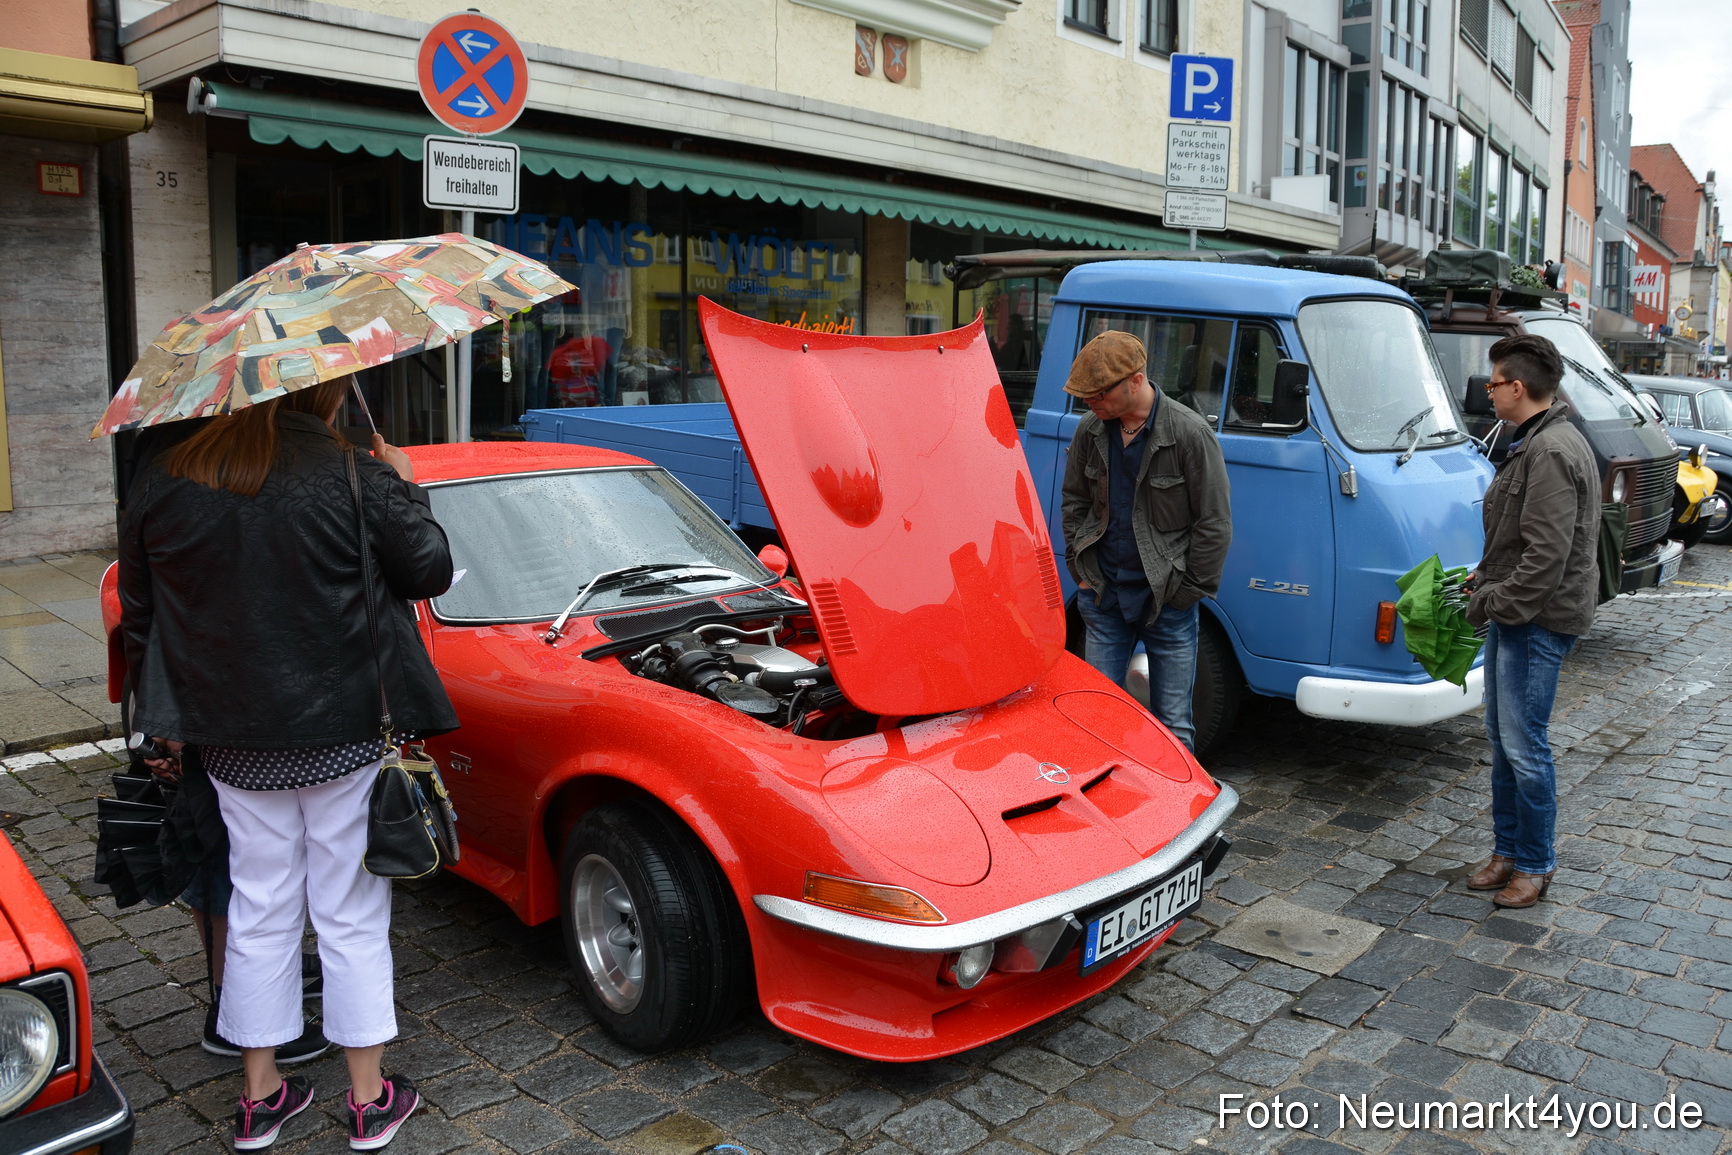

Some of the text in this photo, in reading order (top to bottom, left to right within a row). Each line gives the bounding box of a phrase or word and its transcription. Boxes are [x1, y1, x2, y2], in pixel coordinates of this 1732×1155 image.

[1184, 63, 1219, 111] P
[1181, 130, 1217, 139] nur mit
[1172, 138, 1226, 150] Parkschein
[434, 151, 511, 173] Wendebereich
[1176, 150, 1221, 162] werktags
[156, 170, 178, 188] 35
[1170, 173, 1181, 182] Sa
[446, 177, 498, 196] freihalten
[489, 212, 653, 267] JEANS
[710, 227, 845, 283] WÖLFL
[1634, 271, 1658, 287] H&M
[1249, 578, 1309, 595] E 25
[1099, 911, 1125, 954] EI
[1139, 888, 1164, 931] GT
[1167, 867, 1199, 914] 71H
[1087, 948, 1093, 959] D
